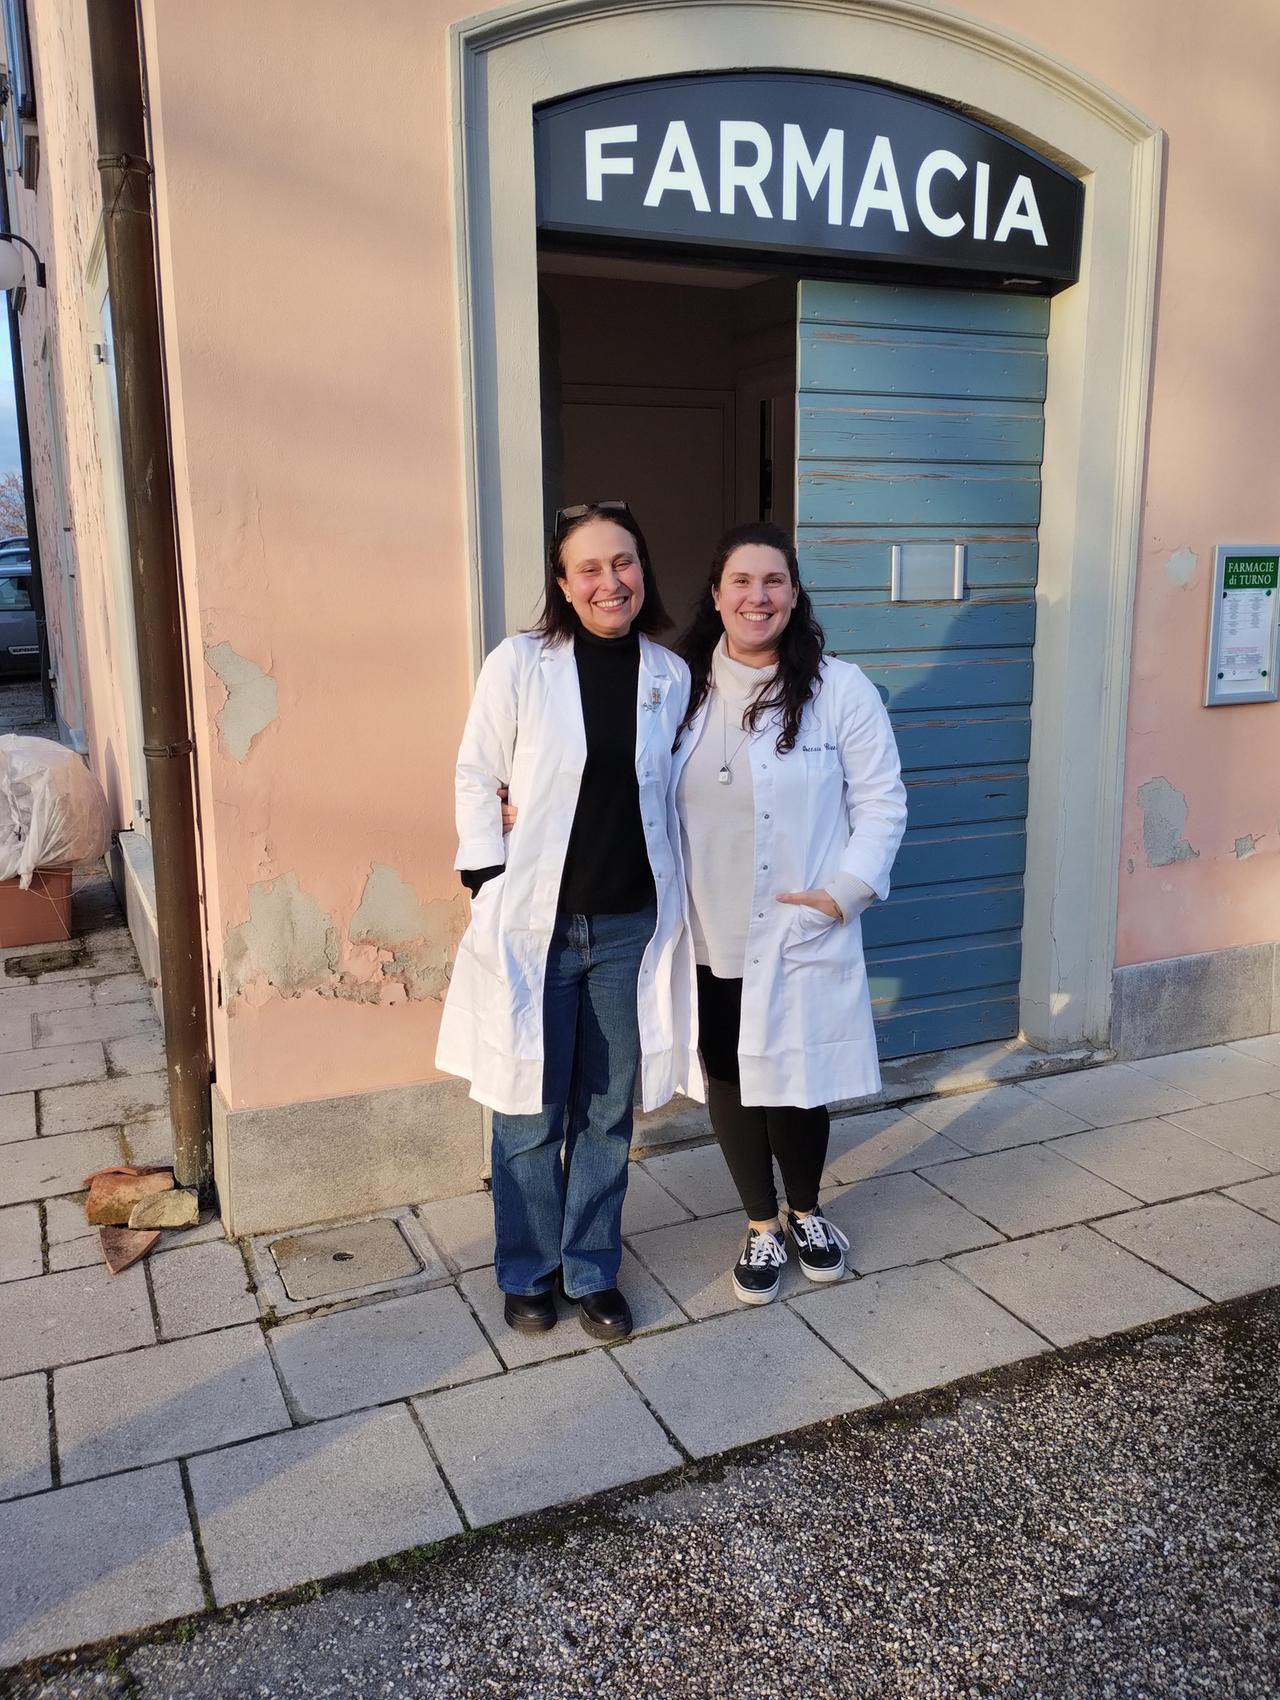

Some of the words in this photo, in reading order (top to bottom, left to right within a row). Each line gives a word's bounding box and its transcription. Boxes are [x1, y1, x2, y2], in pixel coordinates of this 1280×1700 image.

[585, 120, 1049, 247] FARMACIA
[1228, 562, 1275, 573] FARMACIE
[1229, 574, 1237, 585] di
[1239, 574, 1272, 585] TURNO
